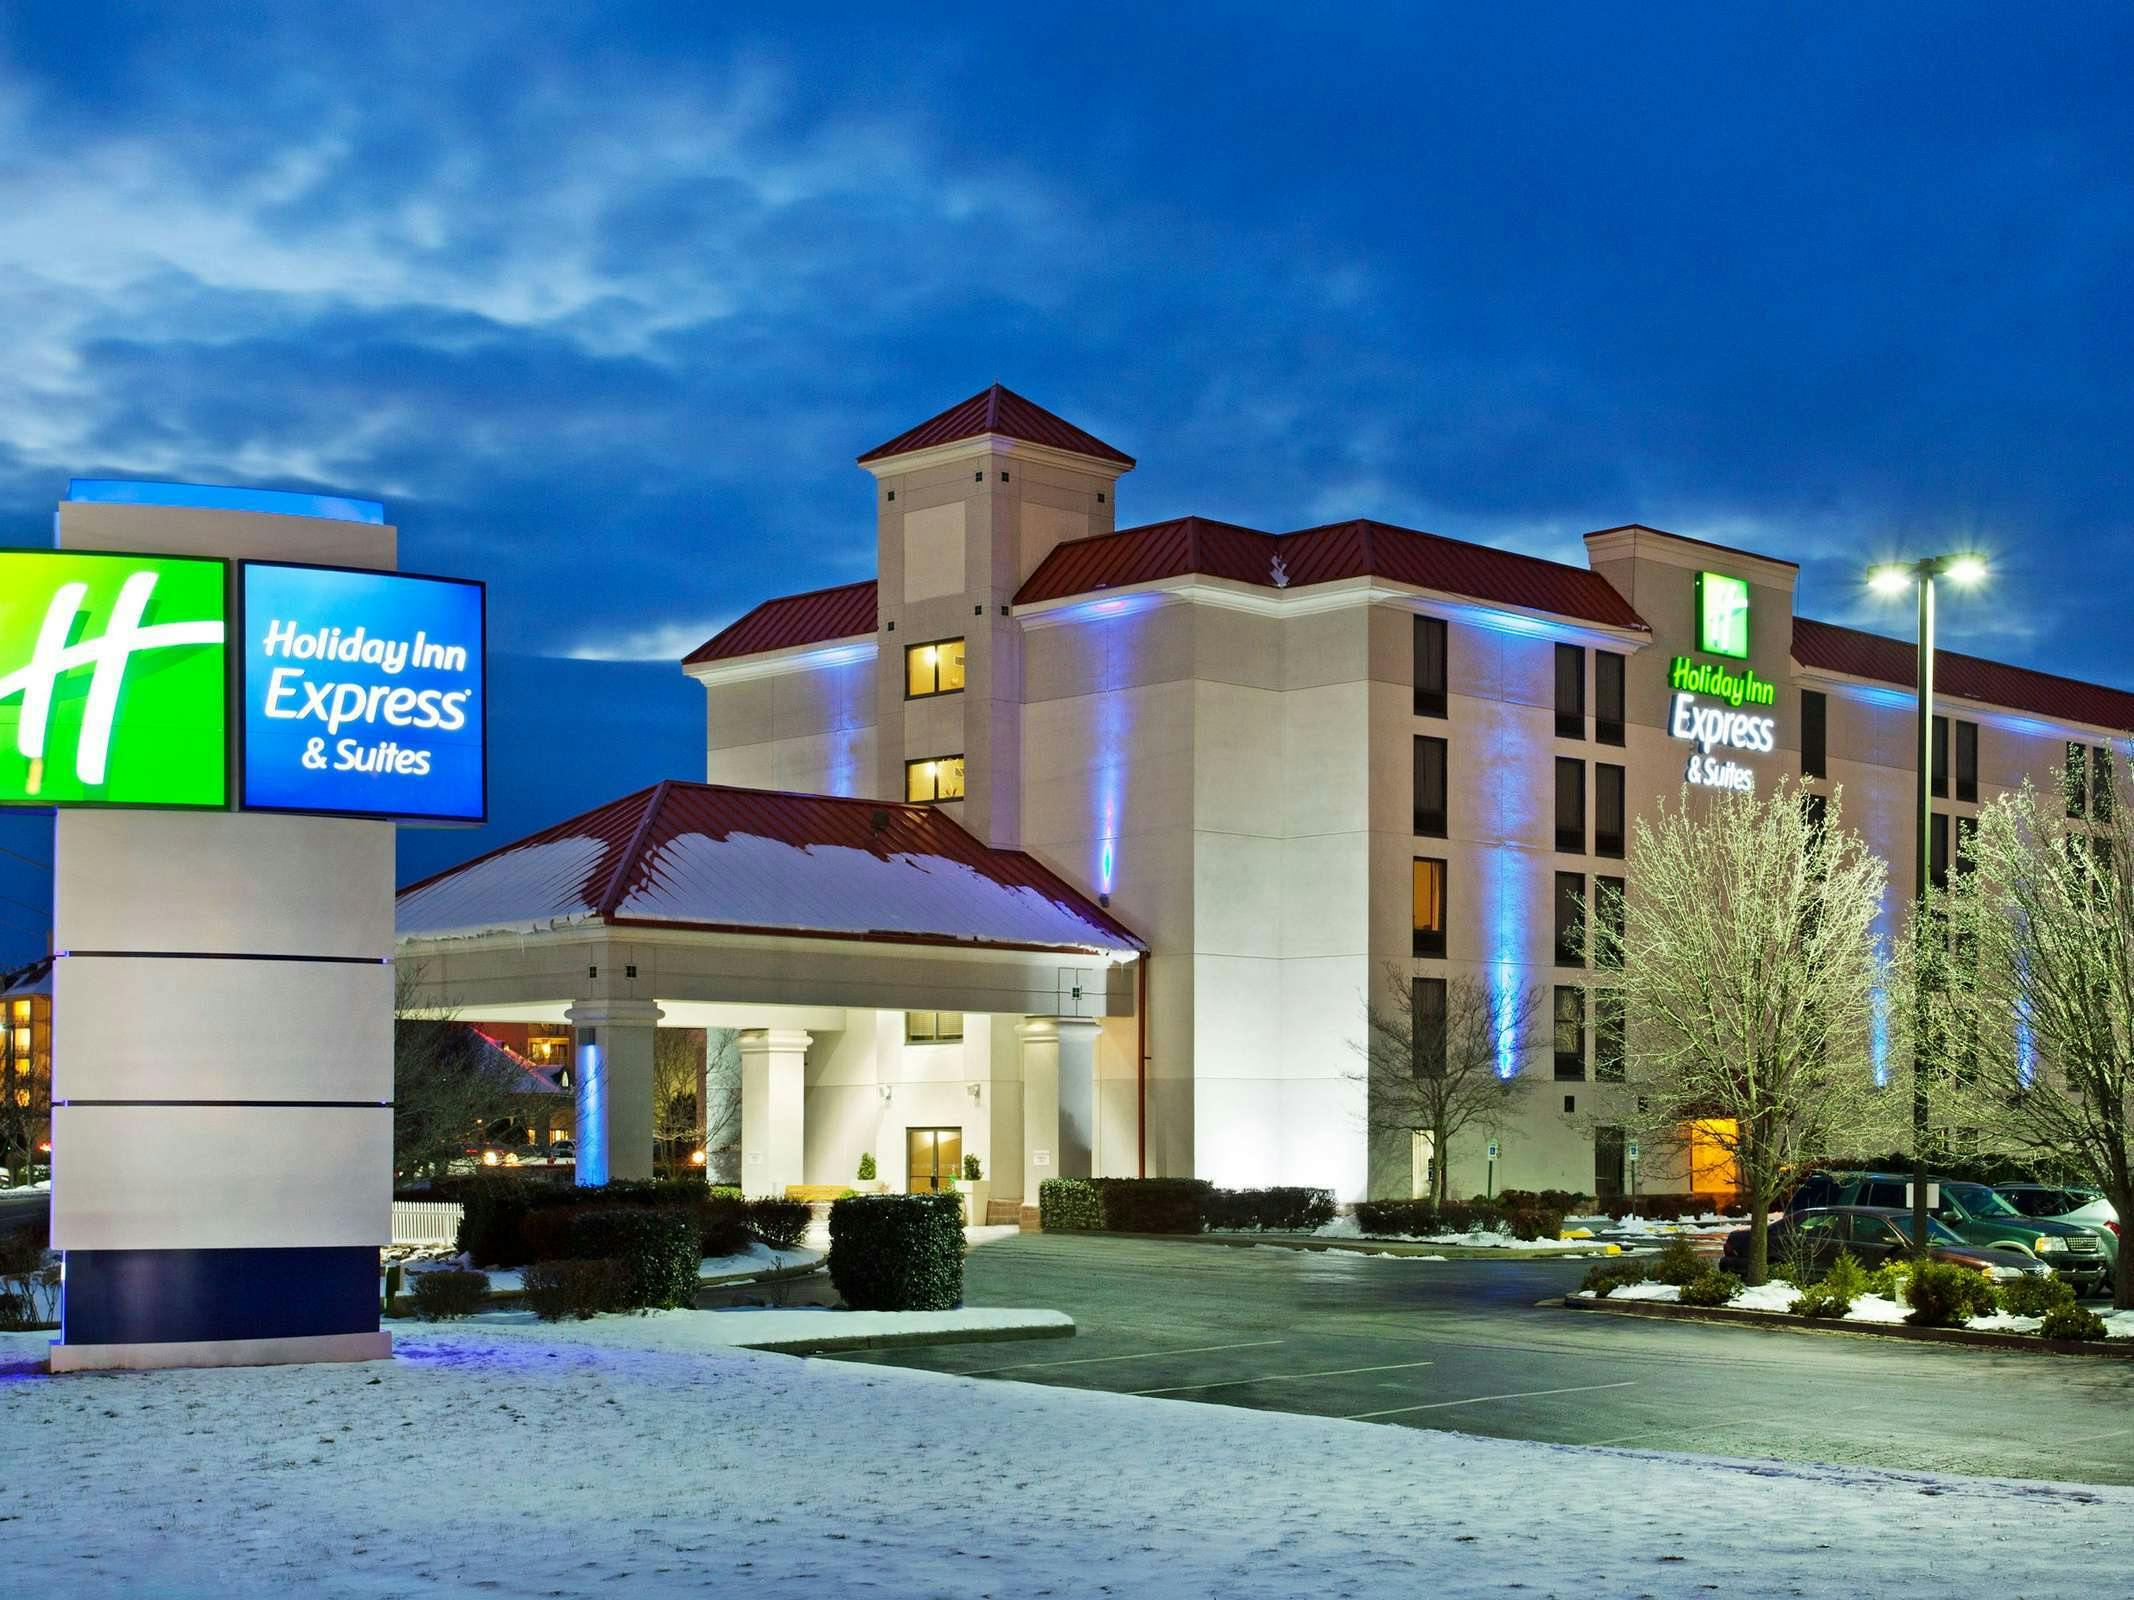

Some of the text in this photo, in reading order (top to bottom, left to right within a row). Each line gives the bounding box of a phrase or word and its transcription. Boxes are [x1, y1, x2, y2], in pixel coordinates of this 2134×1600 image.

[263, 619, 467, 674] Holiday Inn
[264, 666, 468, 735] Express
[1671, 656, 1775, 707] Holiday Inn
[1671, 692, 1776, 754] Express
[302, 736, 432, 775] & Suites
[1686, 755, 1754, 791] & Suites
